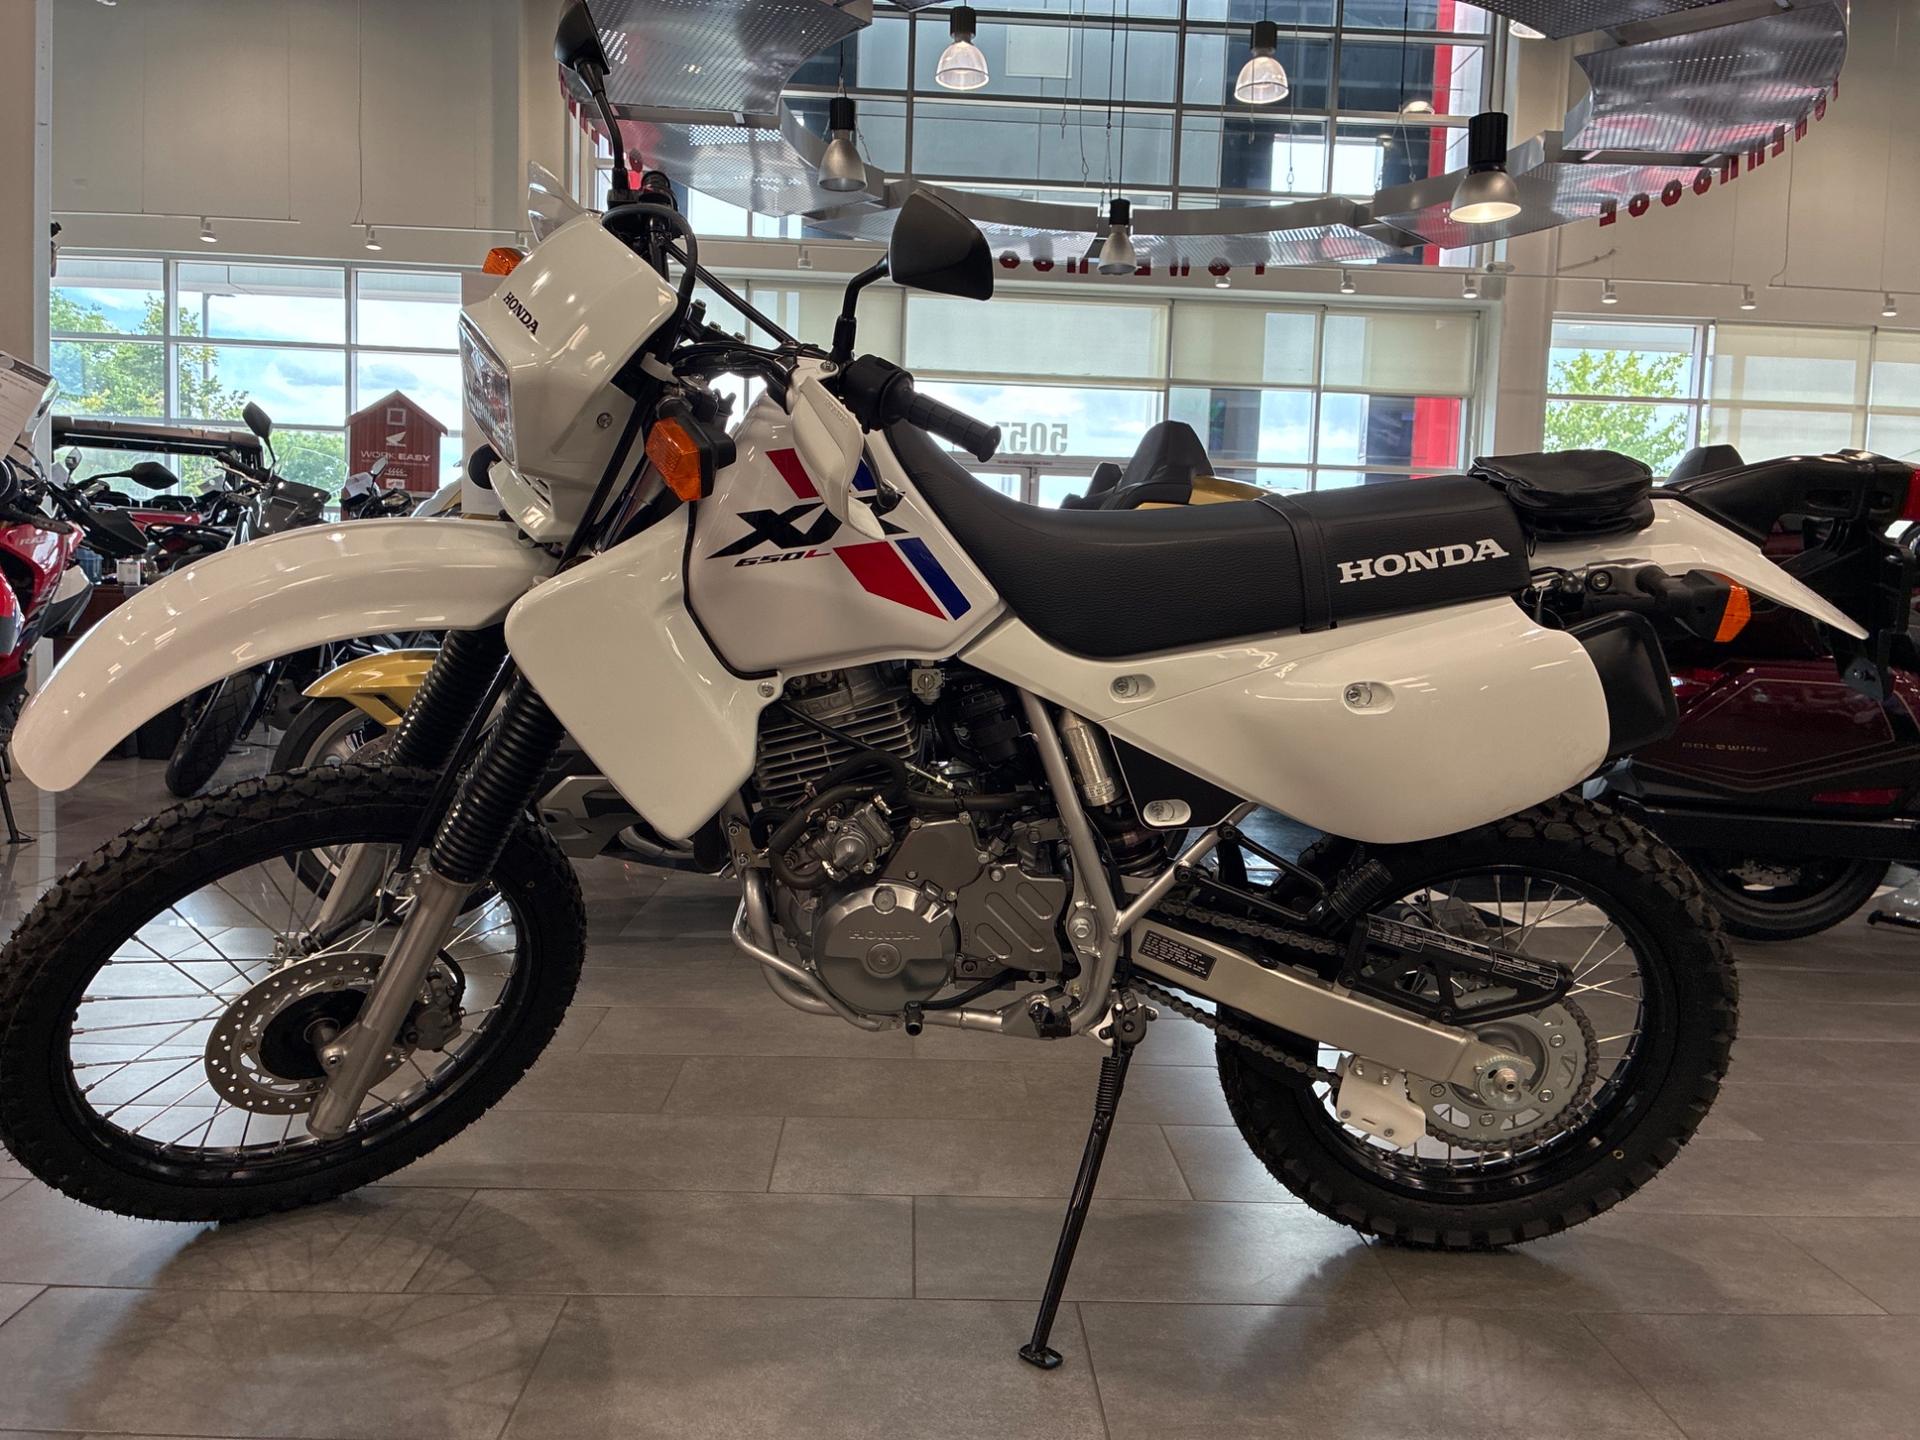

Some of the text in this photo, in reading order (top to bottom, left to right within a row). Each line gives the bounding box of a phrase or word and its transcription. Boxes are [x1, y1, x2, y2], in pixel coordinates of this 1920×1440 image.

[503, 291, 539, 336] HONDA
[398, 452, 431, 462] EASY
[734, 549, 831, 567] 650L
[1337, 538, 1510, 584] HONDA
